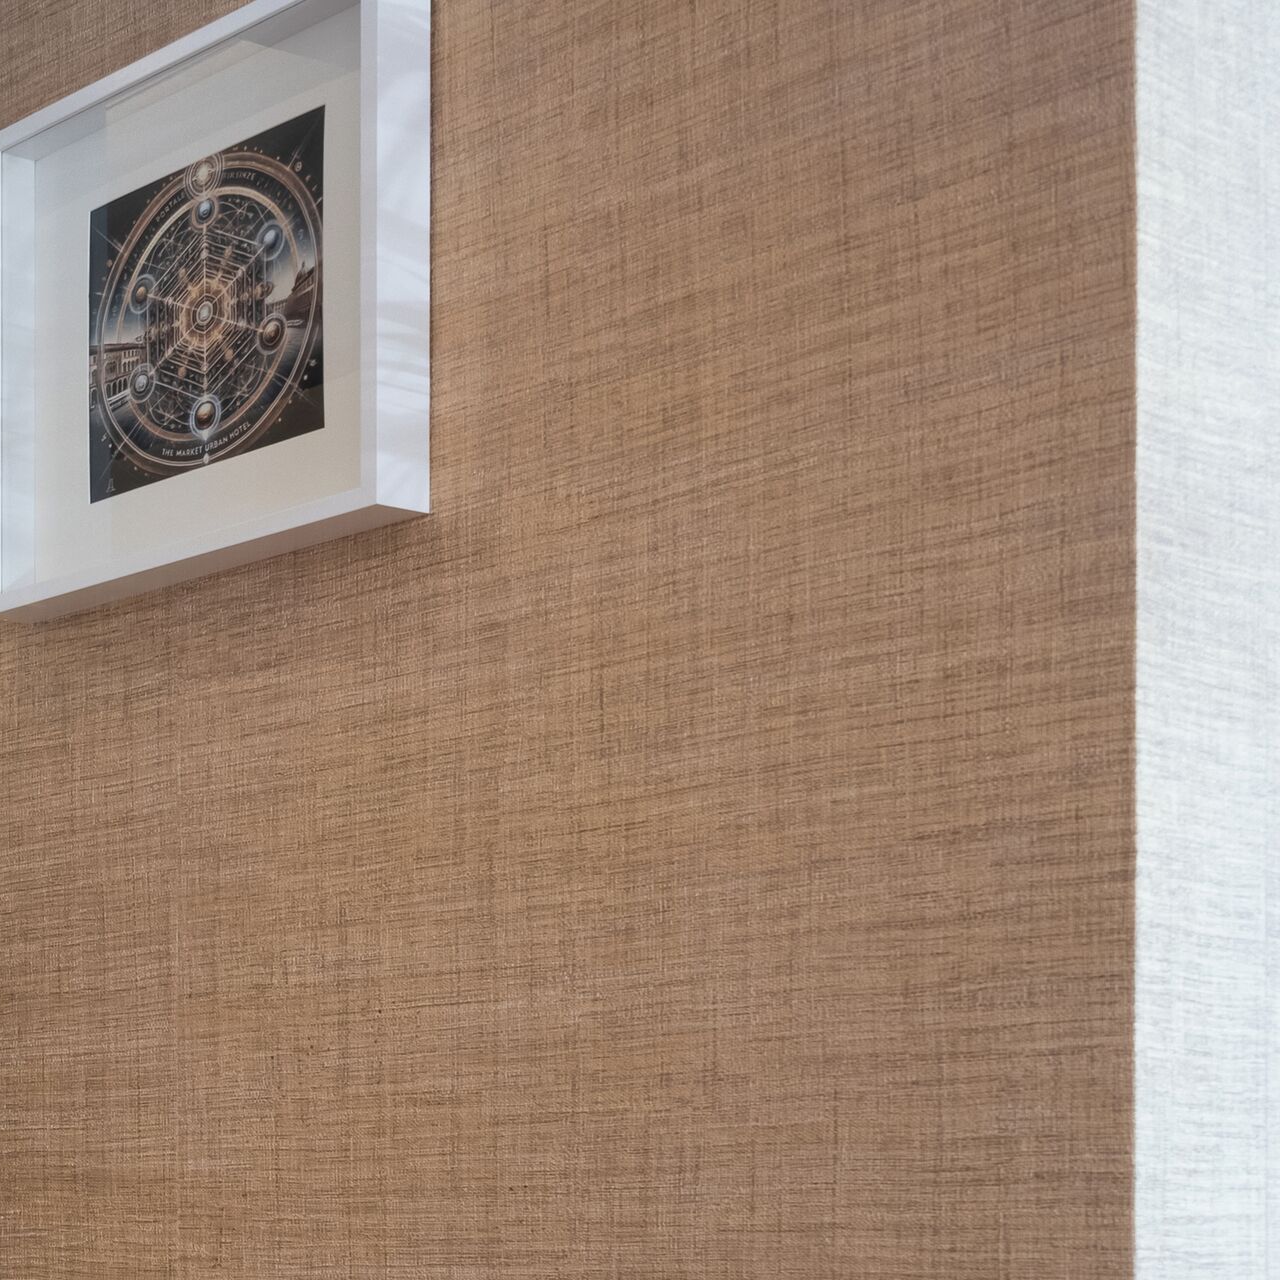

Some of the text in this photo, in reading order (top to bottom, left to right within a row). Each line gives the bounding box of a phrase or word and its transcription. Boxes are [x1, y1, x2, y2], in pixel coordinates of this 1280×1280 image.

[161, 421, 252, 457] THE MARKET URBAN HOTEL
